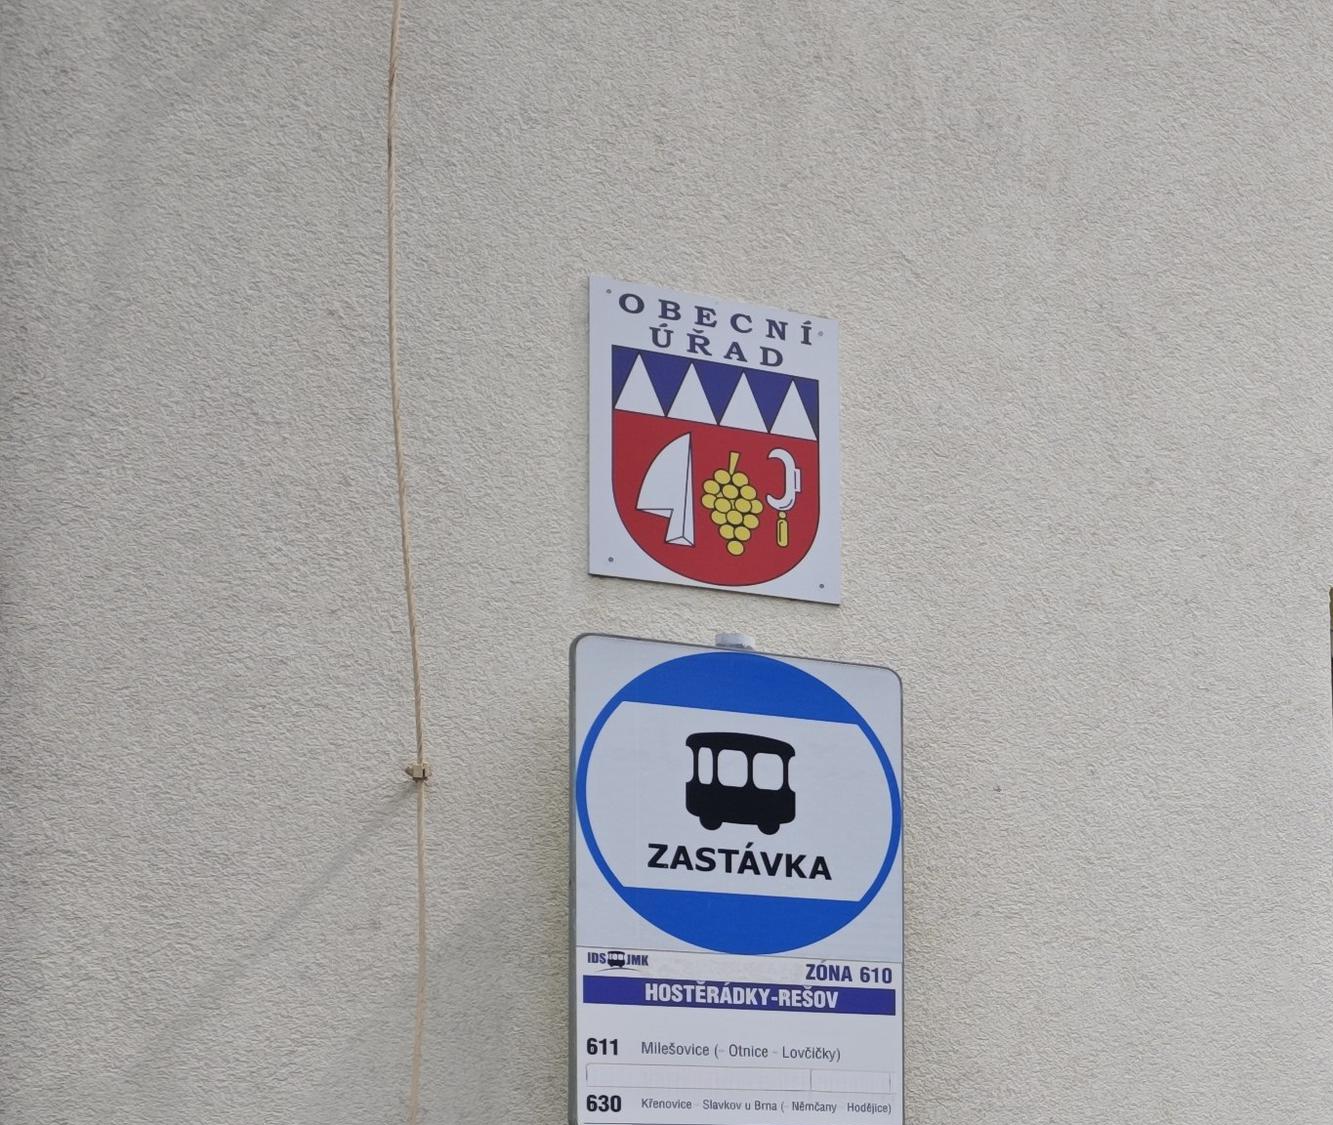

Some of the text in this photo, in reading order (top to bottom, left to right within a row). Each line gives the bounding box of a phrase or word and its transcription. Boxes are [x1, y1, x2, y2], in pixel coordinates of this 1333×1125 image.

[618, 292, 813, 346] OBECNÍ
[649, 323, 784, 368] ÚŘAD
[647, 841, 832, 881] ZASTÁVKA
[587, 951, 607, 965] IDS
[626, 953, 649, 967] JMK
[805, 960, 893, 984] ZÓNA 610
[645, 979, 839, 1009] HOSTĚRÁDKY-REŠOV
[586, 1037, 619, 1056] 611
[640, 1041, 710, 1057] Milešovice
[728, 1044, 769, 1058] Otnice
[782, 1045, 842, 1063] Lovčičky)
[586, 1094, 622, 1112] 630
[641, 1097, 692, 1110] Křenovice
[702, 1099, 742, 1111] Slavkov
[744, 1102, 751, 1111] u
[754, 1100, 778, 1112] Brna
[791, 1100, 838, 1114] Němčany
[847, 1101, 892, 1115] Hodějice)
